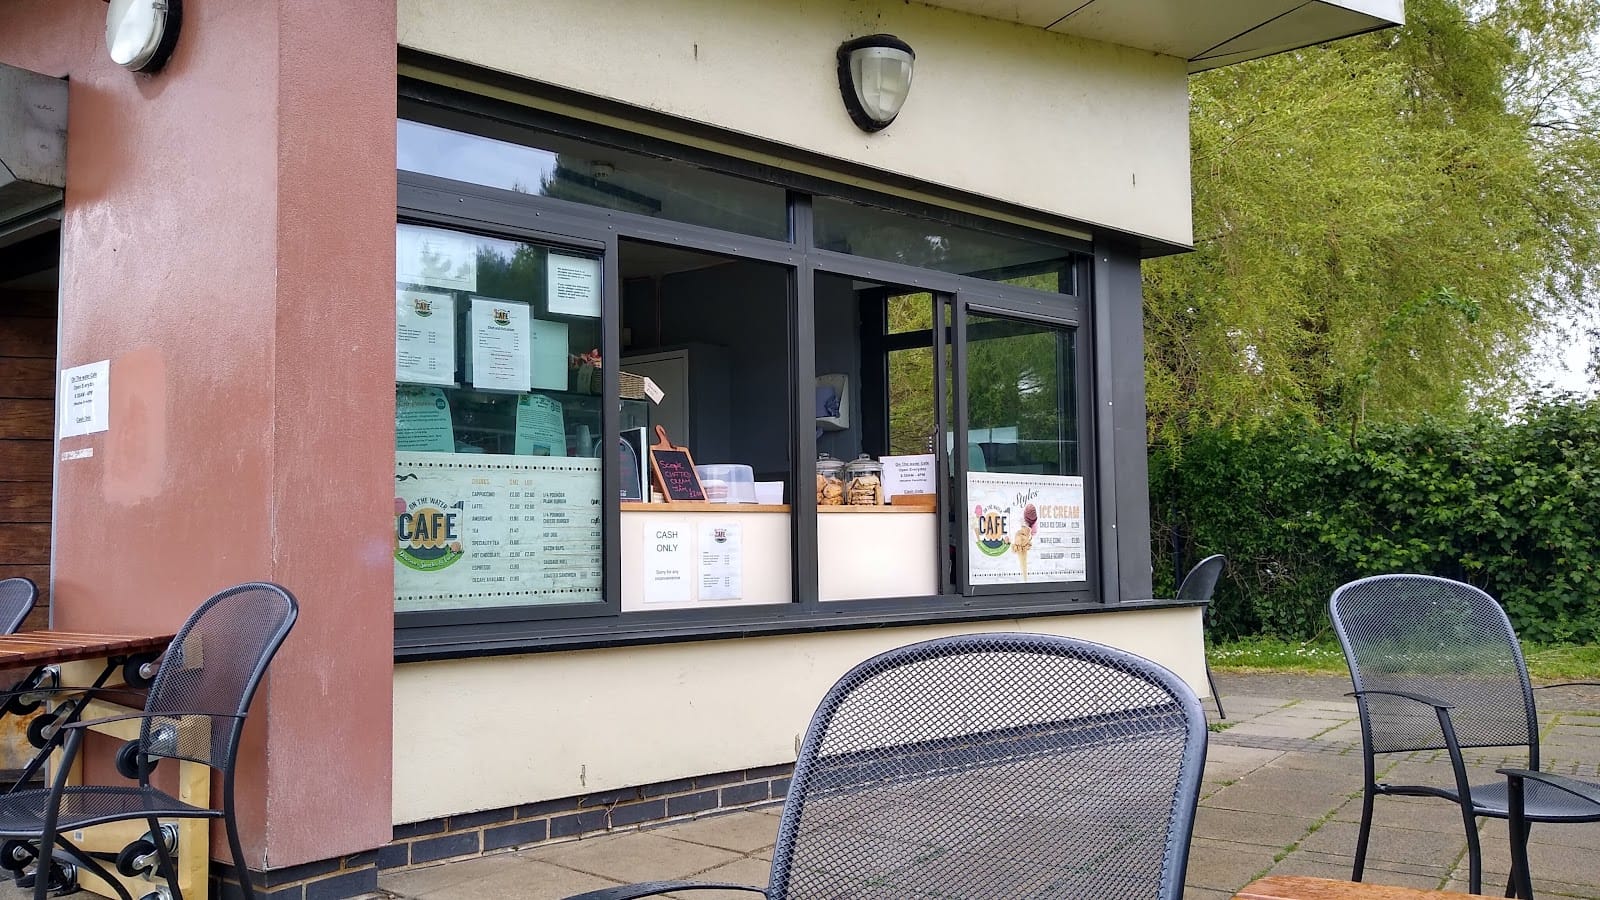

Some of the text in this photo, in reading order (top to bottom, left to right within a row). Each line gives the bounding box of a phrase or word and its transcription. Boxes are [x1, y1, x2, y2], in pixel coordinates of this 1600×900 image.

[408, 497, 449, 511] ON THE WATER
[1013, 488, 1039, 508] Styles
[1039, 504, 1080, 519] ICE CREAM
[398, 512, 458, 541] CAFE
[979, 515, 1008, 535] CAFE
[656, 530, 678, 539] CASH
[656, 543, 679, 553] ONLY
